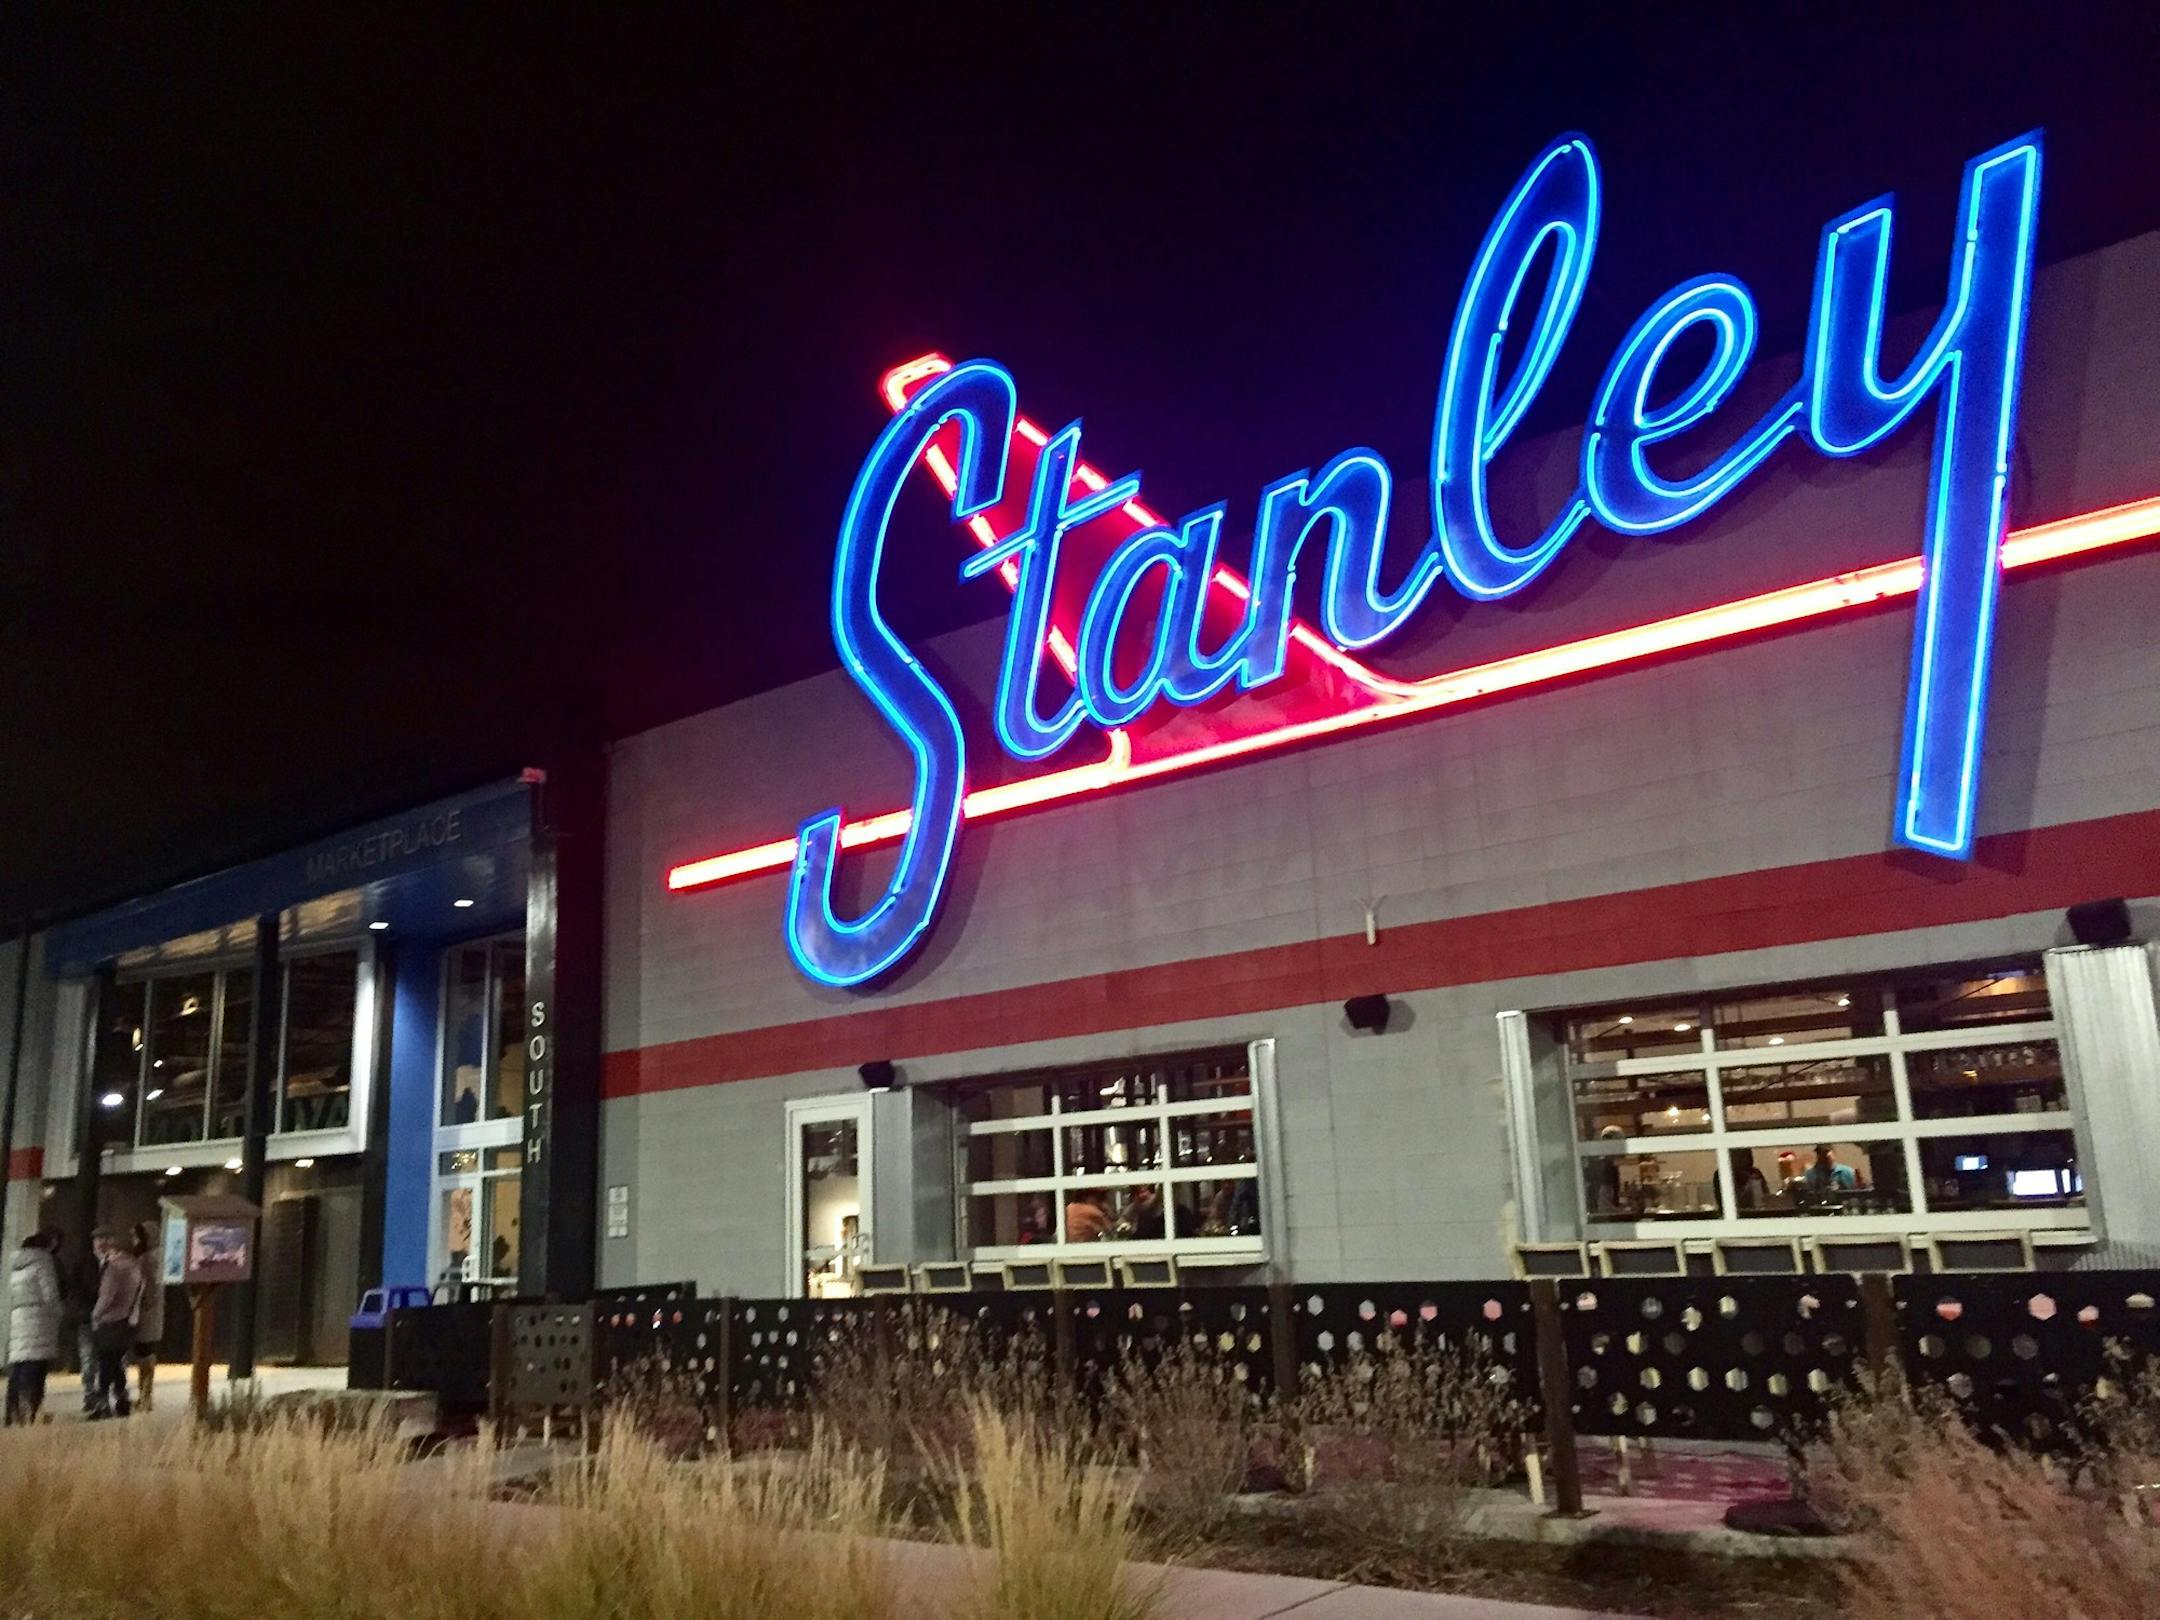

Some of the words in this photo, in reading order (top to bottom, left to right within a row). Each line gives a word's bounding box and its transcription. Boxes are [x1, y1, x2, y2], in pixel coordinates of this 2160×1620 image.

[786, 128, 2044, 989] Stanley
[305, 810, 462, 883] MARKETPLACE
[527, 1000, 546, 1165] SOUTH
